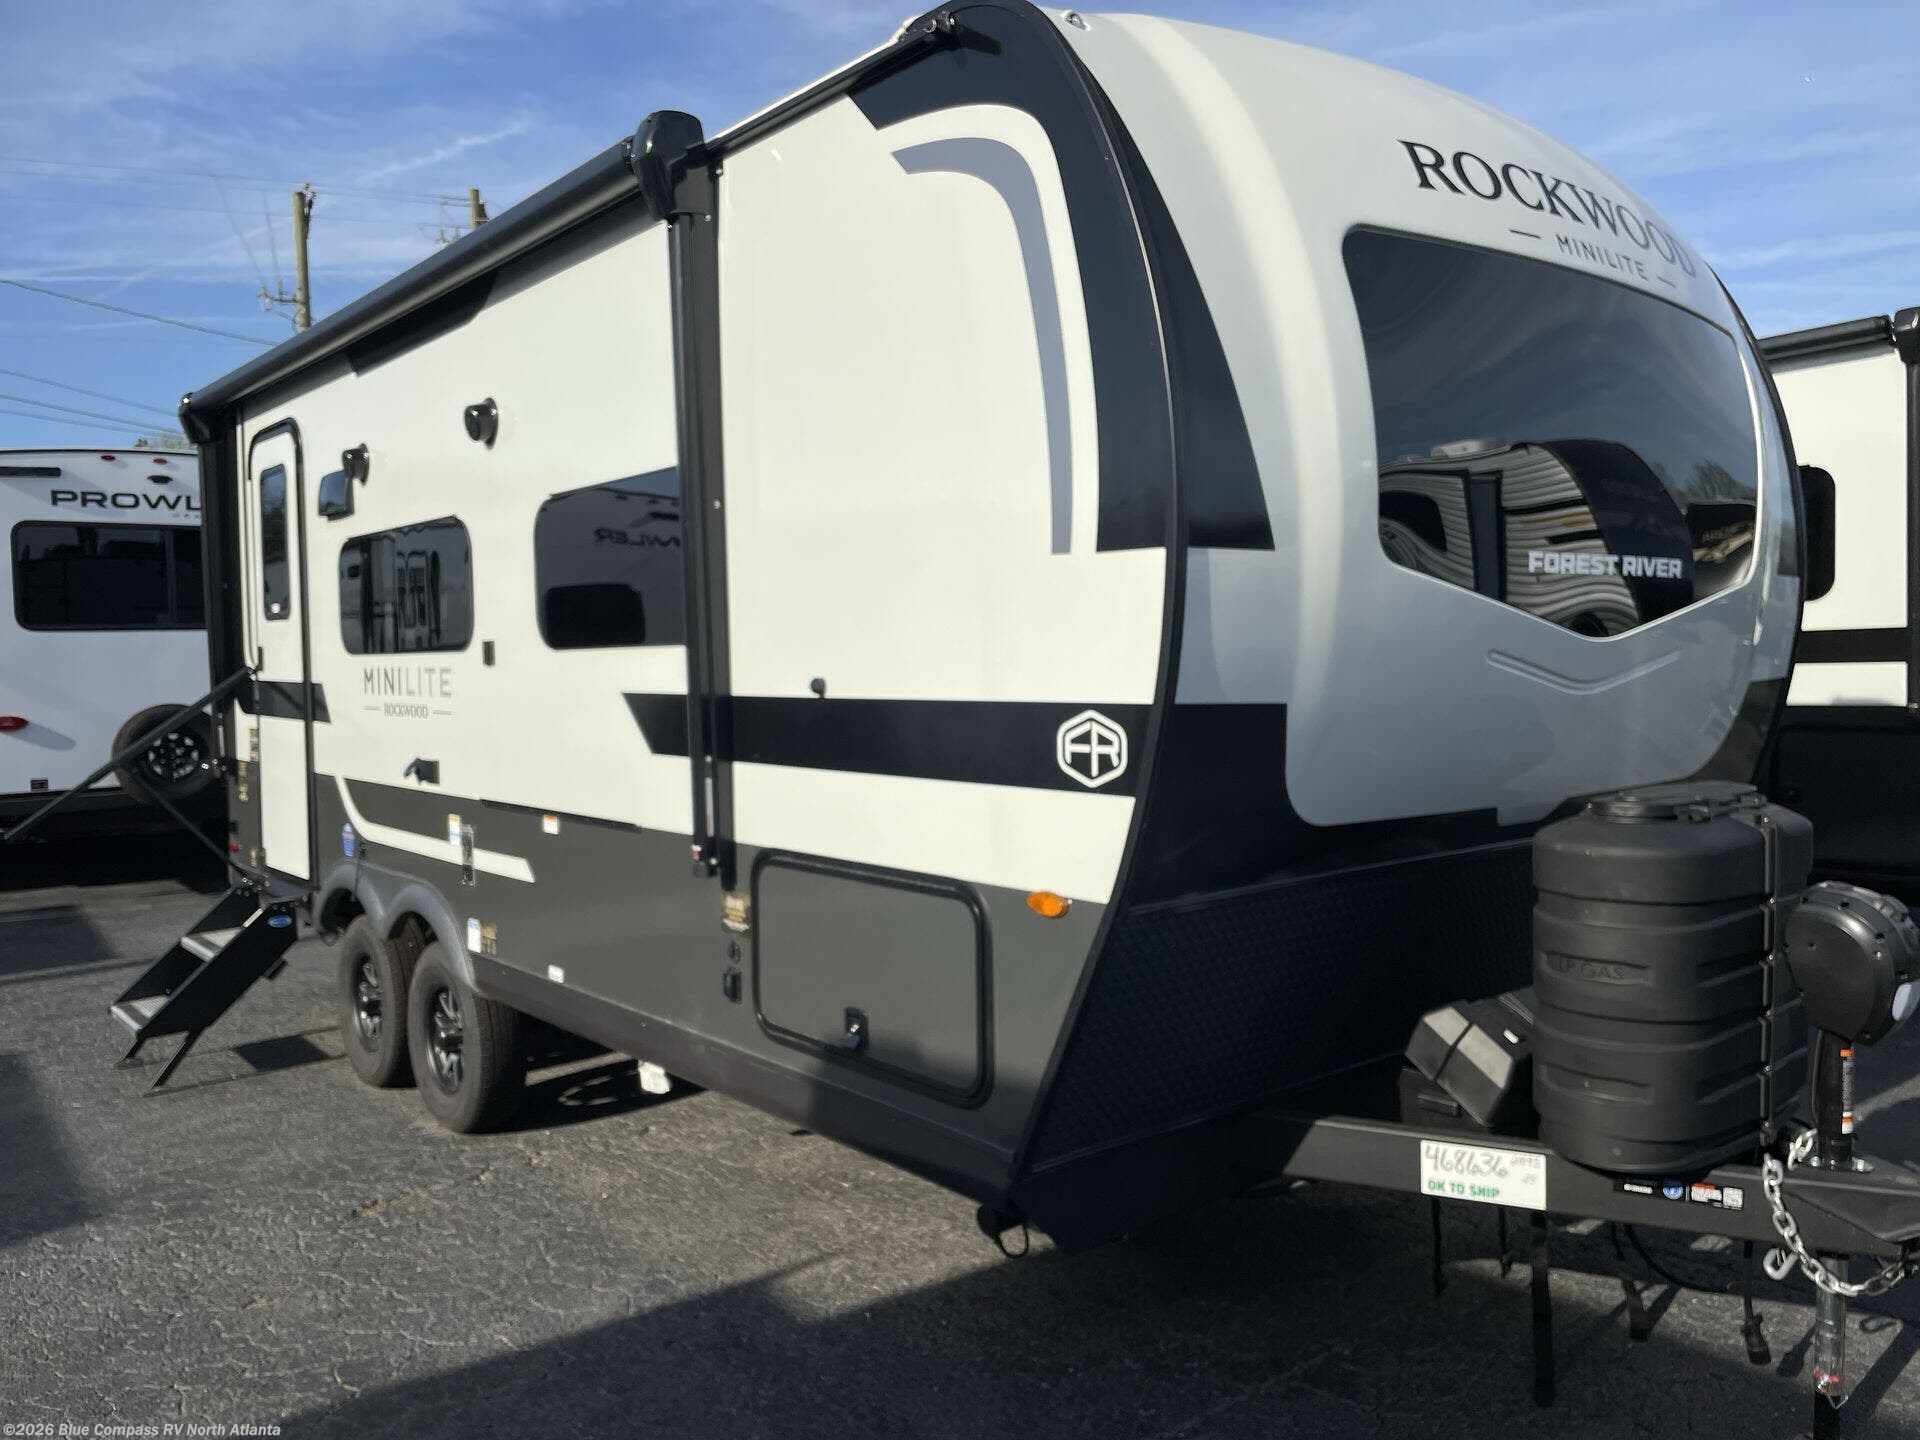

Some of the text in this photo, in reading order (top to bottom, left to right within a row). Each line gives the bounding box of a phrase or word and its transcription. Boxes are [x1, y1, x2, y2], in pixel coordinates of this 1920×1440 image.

[1397, 140, 1696, 278] ROCKWOOD
[1556, 234, 1647, 281] MINILITE
[1528, 551, 1683, 579] FOREST RIVER
[363, 667, 452, 698] MINILITE
[384, 702, 429, 719] ROCKWOOD
[1580, 961, 1625, 980] GAS
[1425, 1145, 1508, 1178] 468636
[1428, 1180, 1500, 1198] OK TO SHIP
